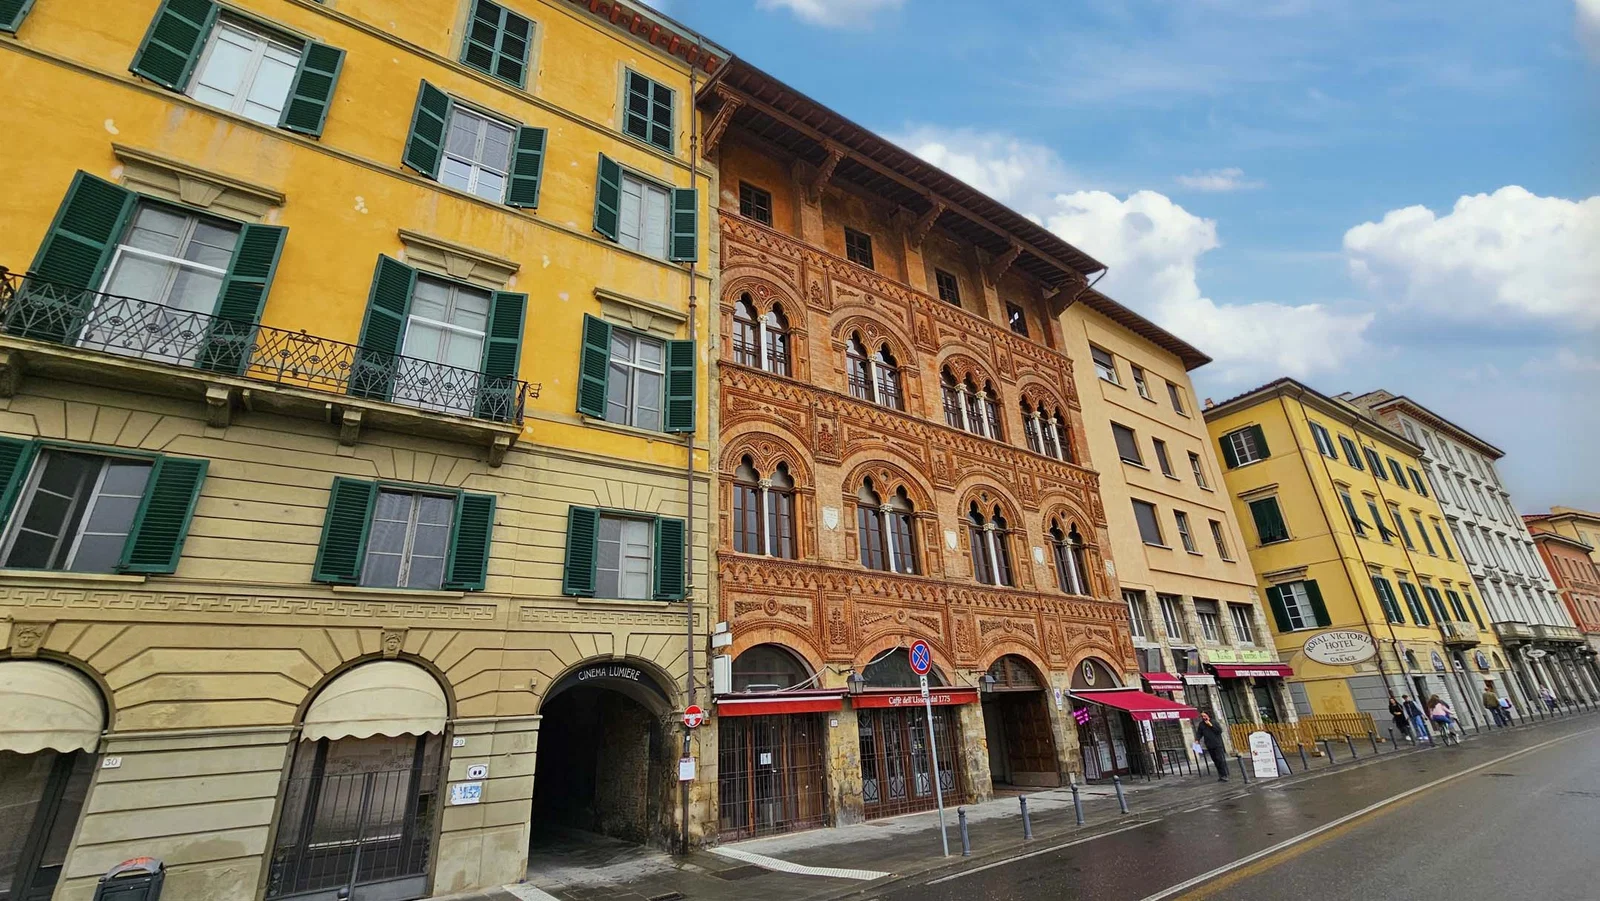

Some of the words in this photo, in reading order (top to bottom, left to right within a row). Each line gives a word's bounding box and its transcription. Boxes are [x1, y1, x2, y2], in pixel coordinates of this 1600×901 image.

[1306, 636, 1328, 653] ROYAL
[1324, 640, 1356, 650] HOTEL
[578, 668, 606, 680] CINEMA
[609, 667, 640, 680] LUMIERE
